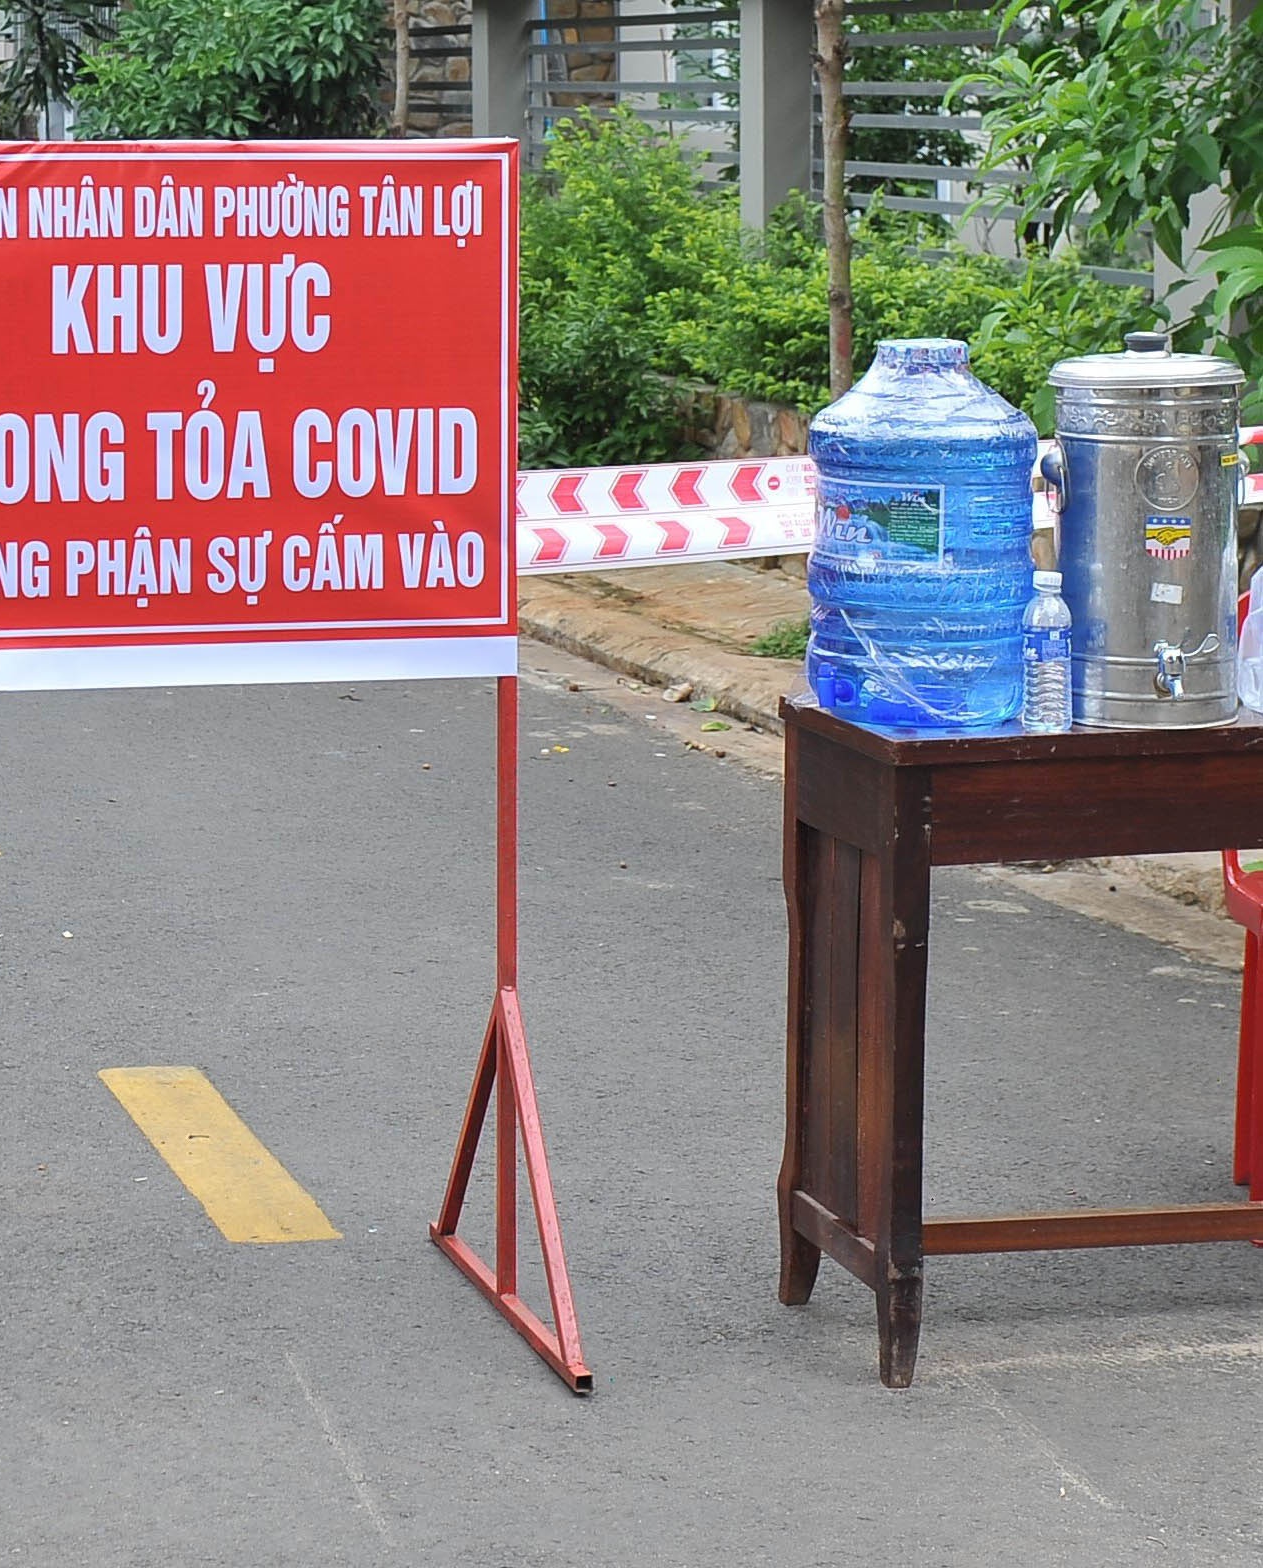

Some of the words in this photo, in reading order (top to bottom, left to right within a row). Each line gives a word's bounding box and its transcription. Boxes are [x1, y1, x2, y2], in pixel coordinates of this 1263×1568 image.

[28, 175, 123, 239] NHÂN
[134, 175, 203, 238] DÂN
[214, 173, 350, 238] PHƯỜNG
[359, 174, 423, 237] TÂN
[433, 180, 483, 248] LỢI
[52, 263, 183, 355] KHU
[204, 253, 331, 373] VỰC
[146, 379, 271, 503] TỎA
[293, 407, 478, 499] COVID
[66, 526, 191, 608] PHẬN
[207, 530, 273, 605] SỰ
[282, 514, 384, 594] CẤM
[397, 520, 485, 589] VÀO
